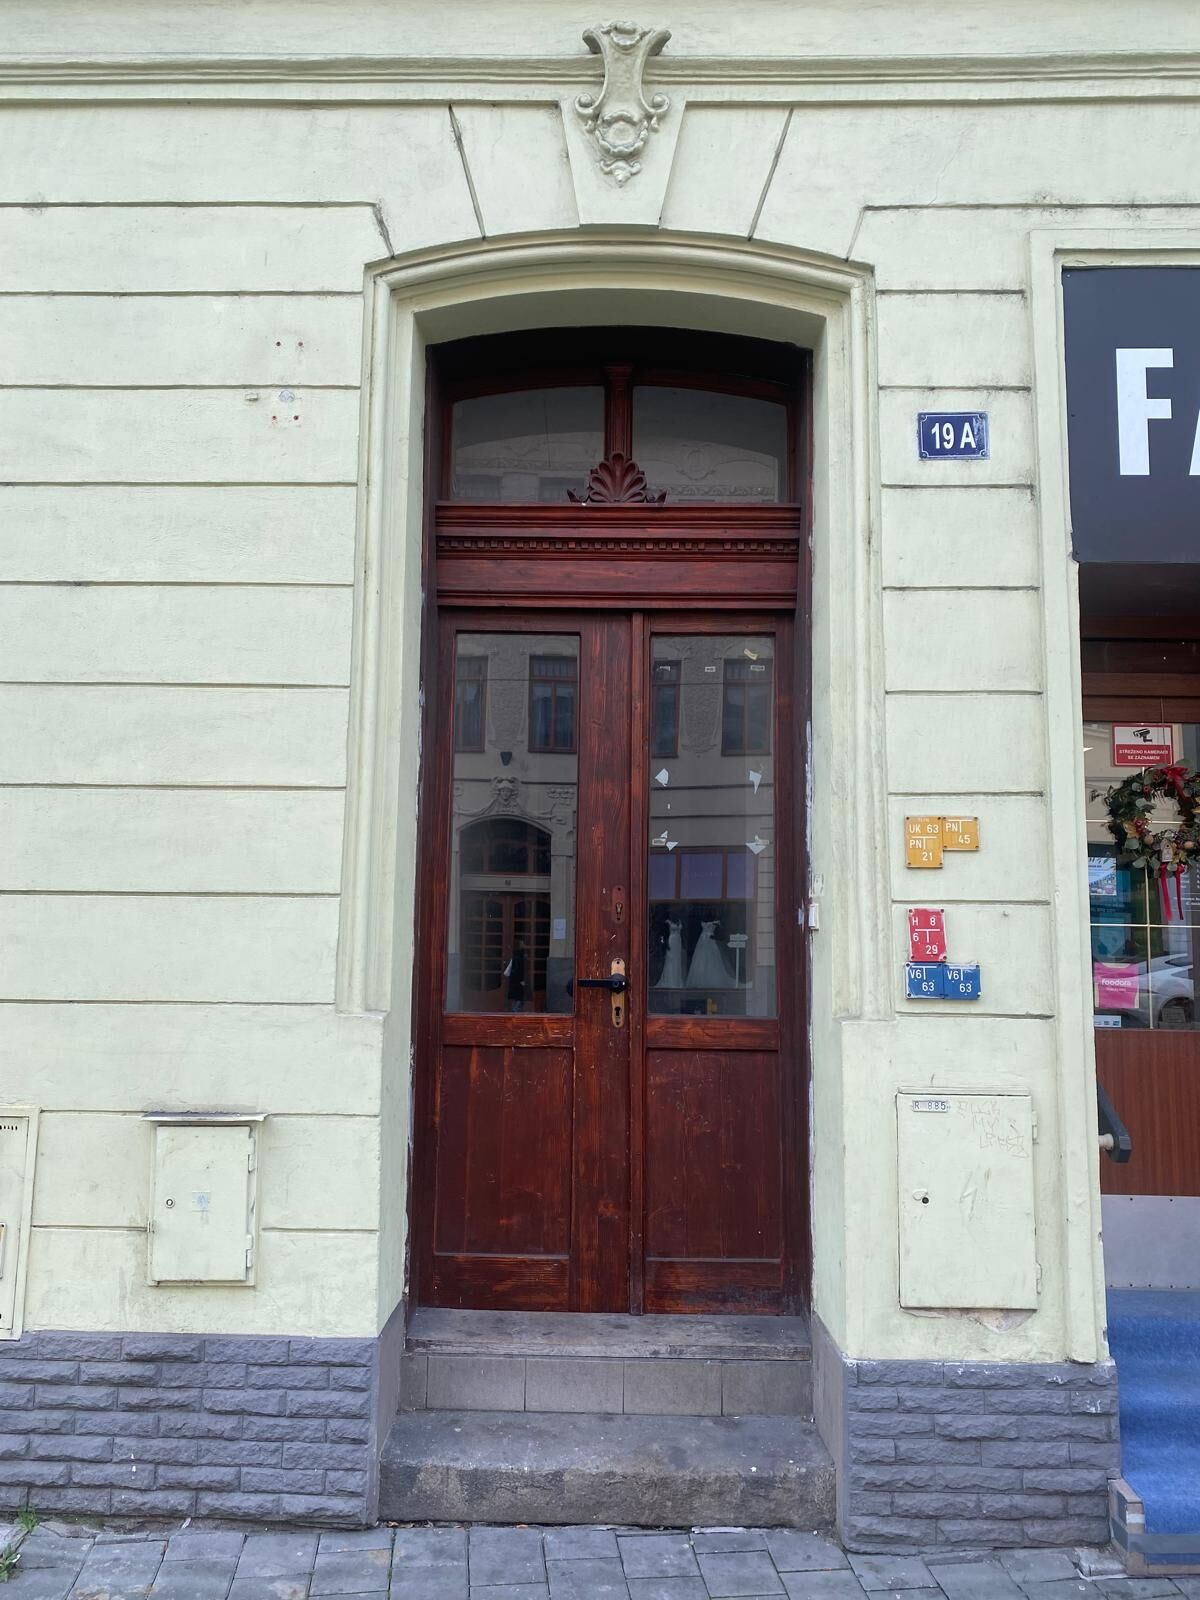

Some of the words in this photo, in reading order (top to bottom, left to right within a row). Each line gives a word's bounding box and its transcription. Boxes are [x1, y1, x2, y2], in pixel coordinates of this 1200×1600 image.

[1116, 348, 1200, 475] F
[931, 422, 955, 450] 19
[960, 422, 977, 449] A
[909, 823, 921, 834] UK
[926, 823, 939, 834] 63
[945, 822, 958, 833] PN
[909, 839, 922, 849] PN
[958, 834, 971, 844] 45
[922, 851, 933, 862] 21
[912, 916, 919, 926] H
[930, 916, 936, 926] 8
[912, 932, 919, 942] 6
[925, 944, 938, 955] 29
[909, 969, 922, 979] V6
[947, 970, 959, 980] V6
[921, 982, 935, 992] 63
[959, 983, 972, 993] 63
[914, 1101, 920, 1110] R
[927, 1101, 946, 1110] 885
